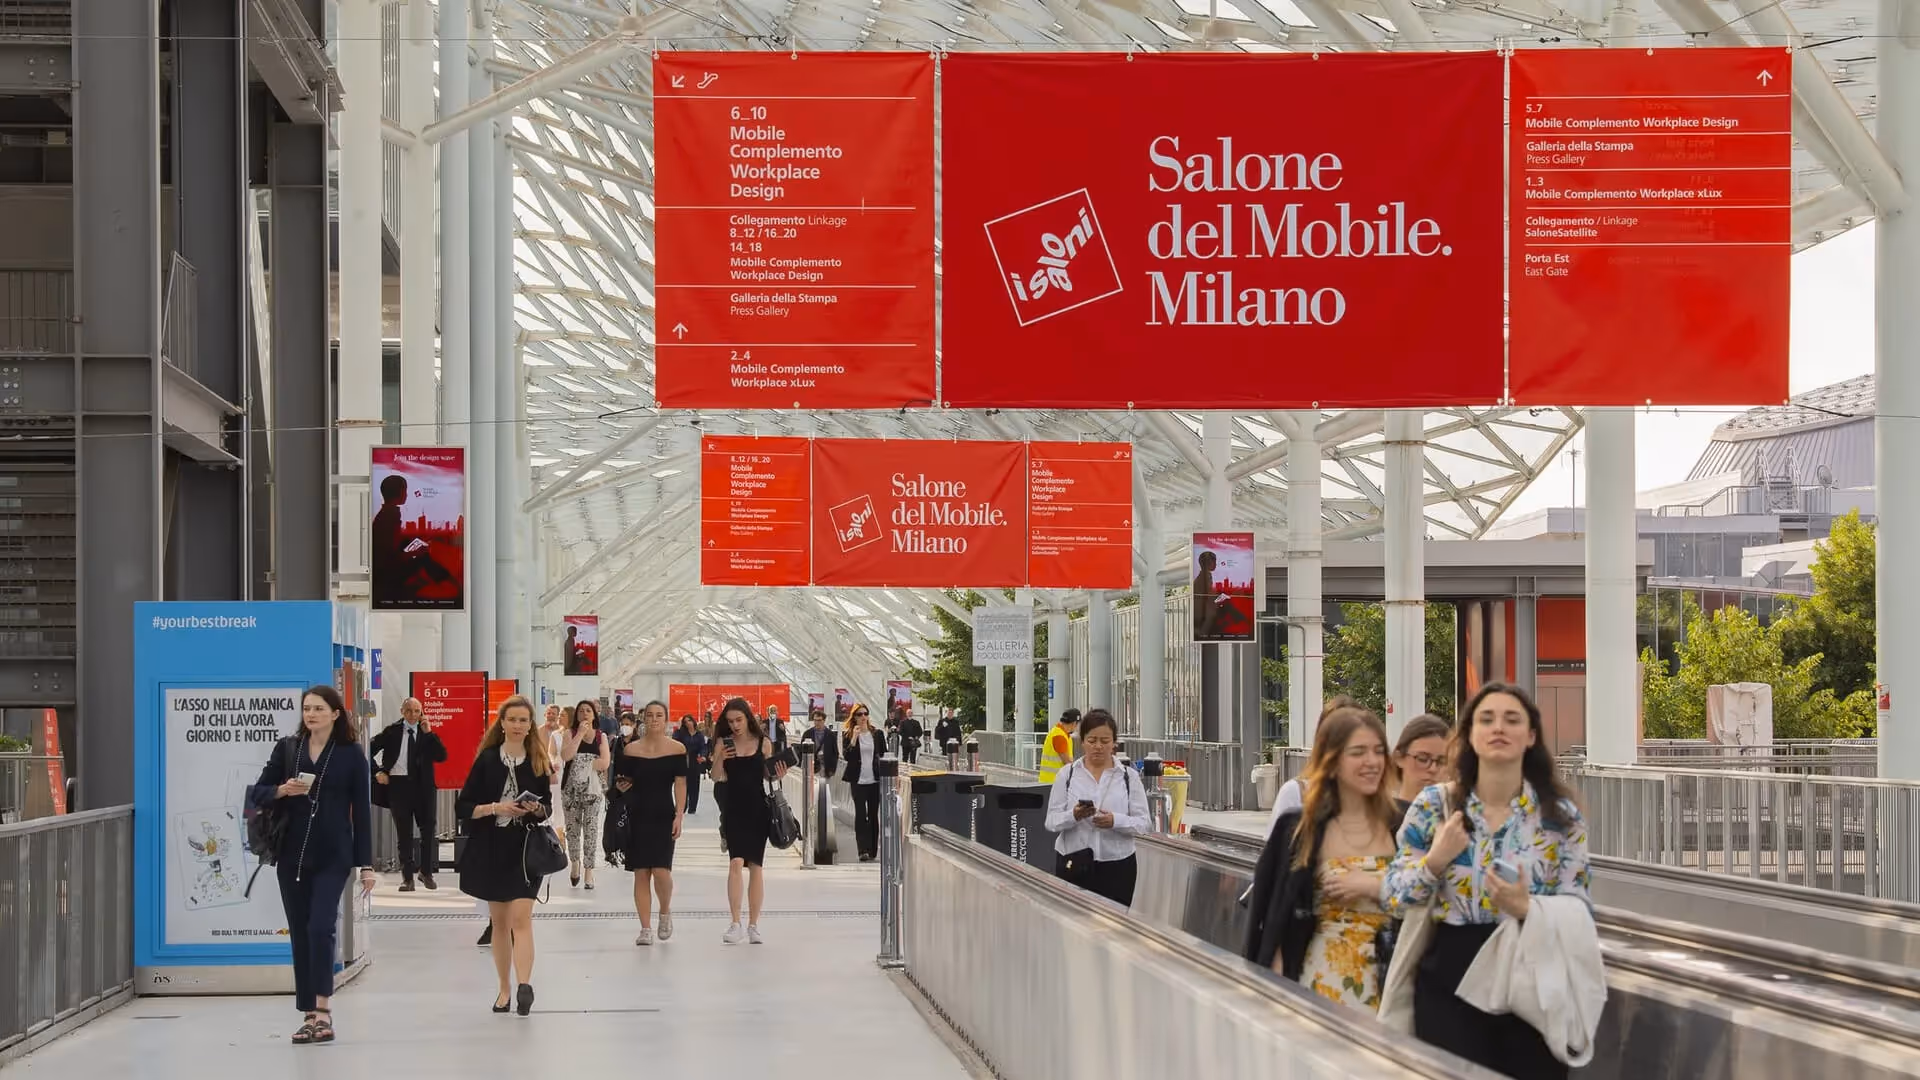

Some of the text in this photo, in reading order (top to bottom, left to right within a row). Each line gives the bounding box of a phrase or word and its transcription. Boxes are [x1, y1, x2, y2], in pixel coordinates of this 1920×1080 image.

[731, 107, 766, 120] 6_10
[1526, 104, 1542, 112] 5_7
[1526, 117, 1738, 129] Mobile Complemento Workplace Design
[731, 126, 785, 140] Mobile
[730, 144, 842, 161] Complemento
[1527, 141, 1633, 152] Galleria della Stampa
[1150, 136, 1342, 192] Salone
[1527, 154, 1585, 166] Press Gallery
[731, 164, 820, 182] Workplace
[1527, 177, 1543, 186] 1_3
[731, 183, 784, 201] Design
[1526, 189, 1721, 200] Mobile Complemento Workplace xLux
[730, 215, 847, 227] Collegamento Linkage
[1526, 217, 1594, 227] Collegamento
[1603, 216, 1637, 227] Linkage
[730, 228, 796, 238] 8_12 / 16_20
[1148, 202, 1452, 259] del Mobile.
[1526, 228, 1597, 236] SaloneSatellite
[731, 242, 762, 253] 14_18
[731, 257, 841, 268] Mobile Complemento
[1526, 254, 1569, 263] Porta Est
[731, 270, 823, 282] Workplace Design
[1526, 267, 1568, 276] East Gate
[731, 293, 837, 304] Galleria della Stampa
[1146, 271, 1345, 326] Milano
[731, 306, 789, 317] Press Gallery
[731, 351, 750, 360] 2_4
[731, 364, 844, 375] Mobile Complemento
[732, 378, 815, 389] Workplace xLux
[893, 473, 965, 497] Salone
[892, 502, 1007, 526] del Mobile.
[891, 530, 967, 553] Milano
[153, 616, 256, 630] #yourbestbreak
[976, 641, 1029, 651] GALLERIA
[424, 688, 449, 700] 6_10
[214, 699, 245, 710] NELLA
[250, 698, 294, 710] MANICA
[194, 714, 274, 726] DI CHI LAVORA
[187, 730, 281, 744] GIORNO E NOTTE
